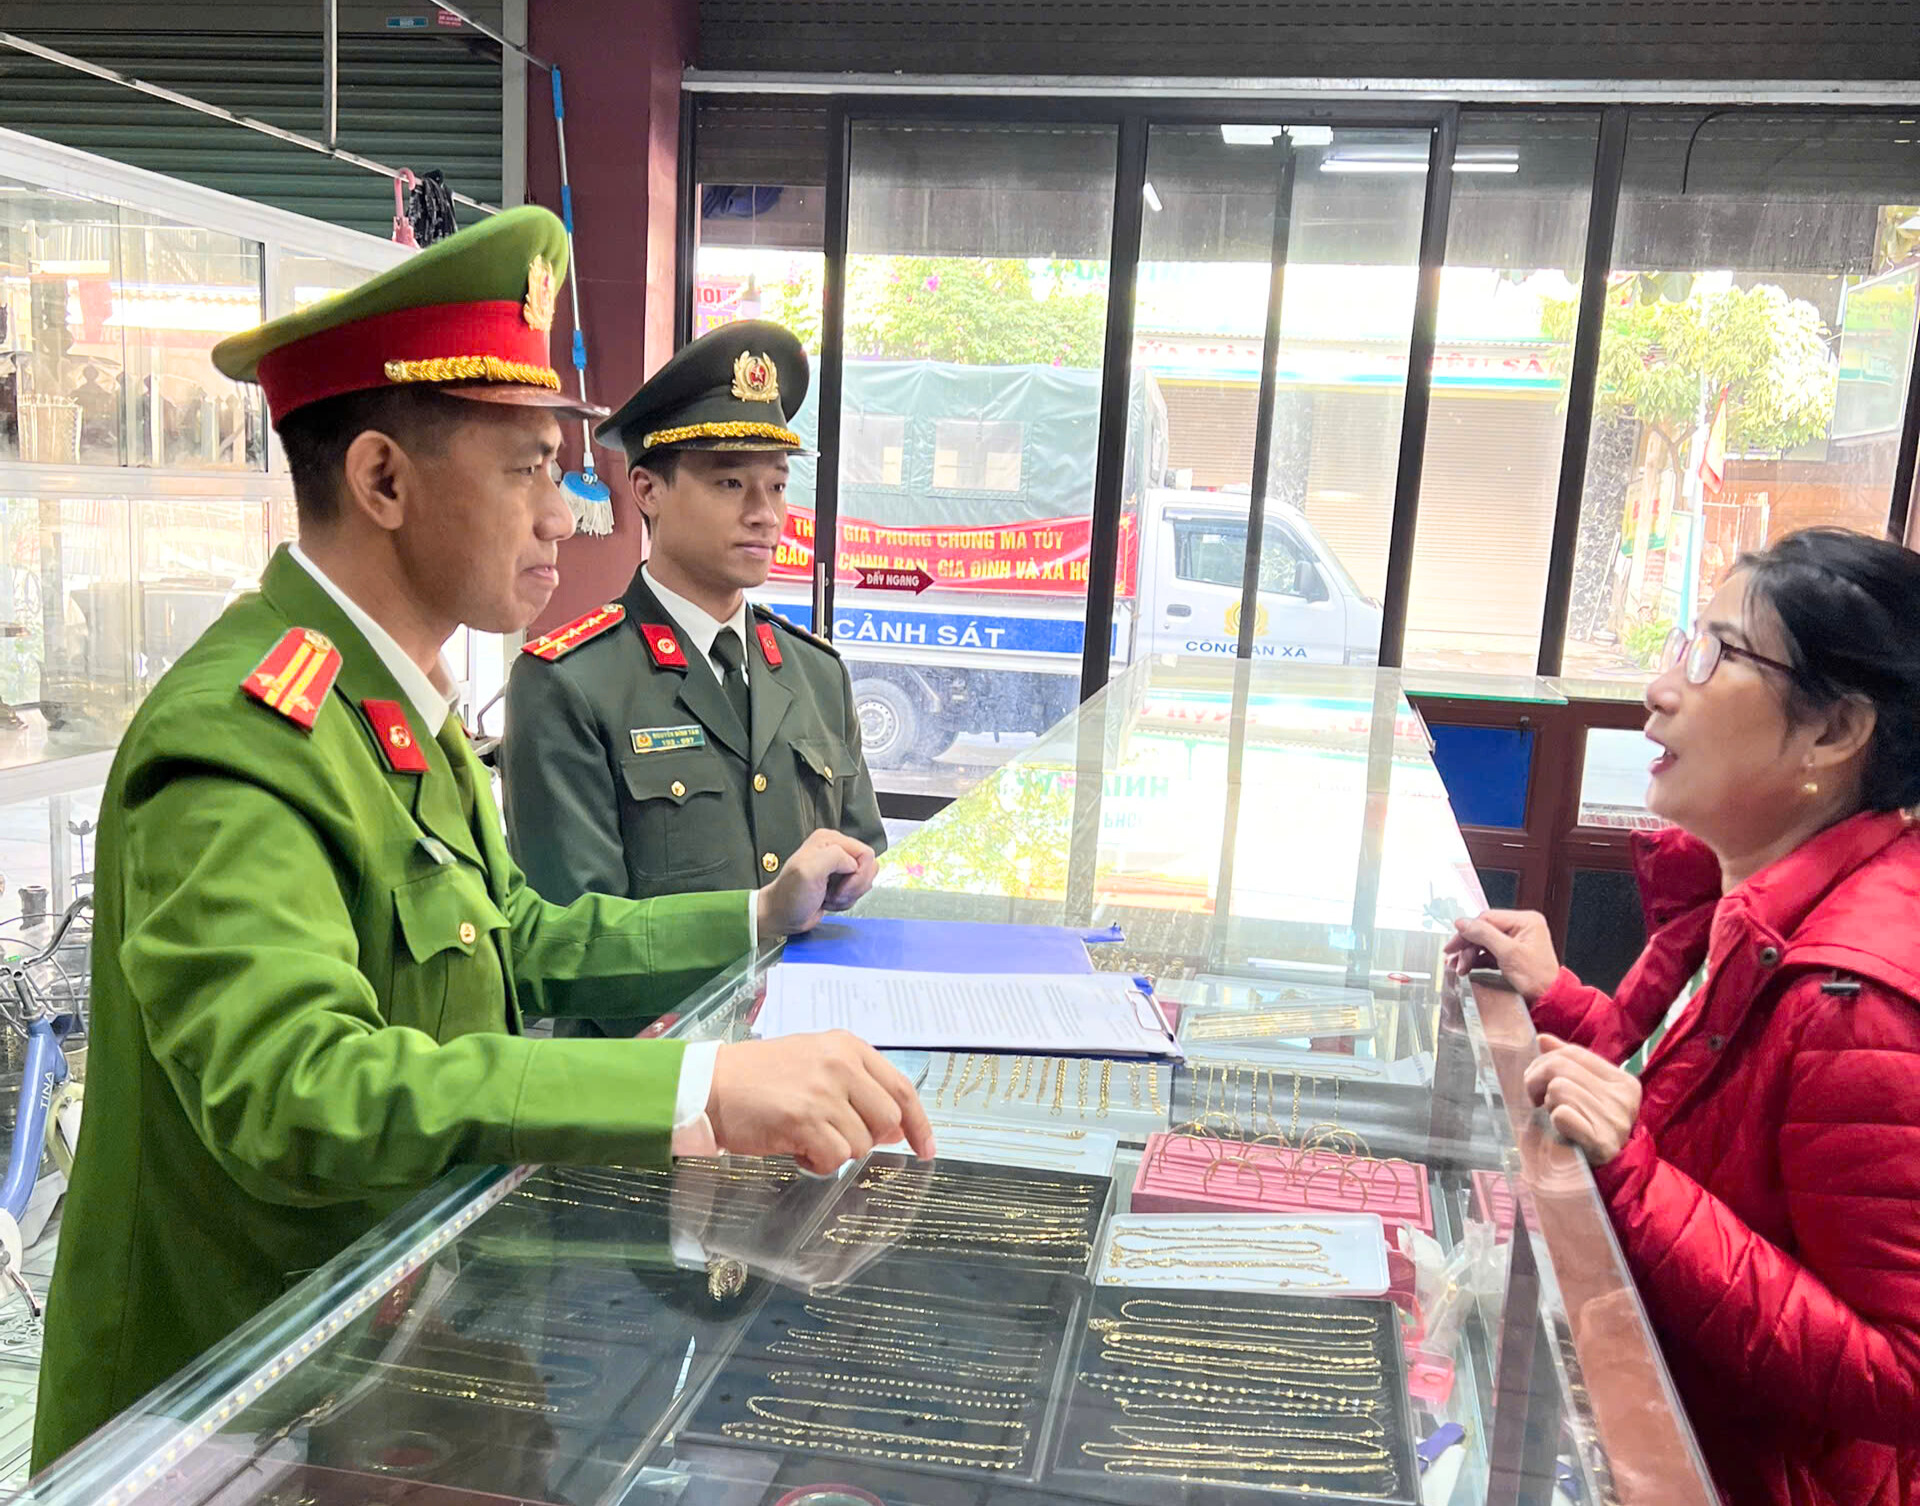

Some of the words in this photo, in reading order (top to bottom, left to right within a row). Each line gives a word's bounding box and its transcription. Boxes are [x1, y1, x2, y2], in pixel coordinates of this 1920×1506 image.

[843, 524, 870, 544] GIA
[1000, 531, 1027, 550] MA
[1032, 526, 1064, 550] TÚY
[776, 539, 809, 566] BẢO
[937, 558, 965, 578] GIA
[1016, 556, 1040, 580] VÀ
[886, 573, 920, 586] NGANG
[832, 611, 927, 644] CẢNH
[936, 620, 1006, 648] SÁT
[1251, 645, 1275, 656] AN
[1282, 643, 1308, 658] XÃ
[39, 1071, 54, 1110] TINA
